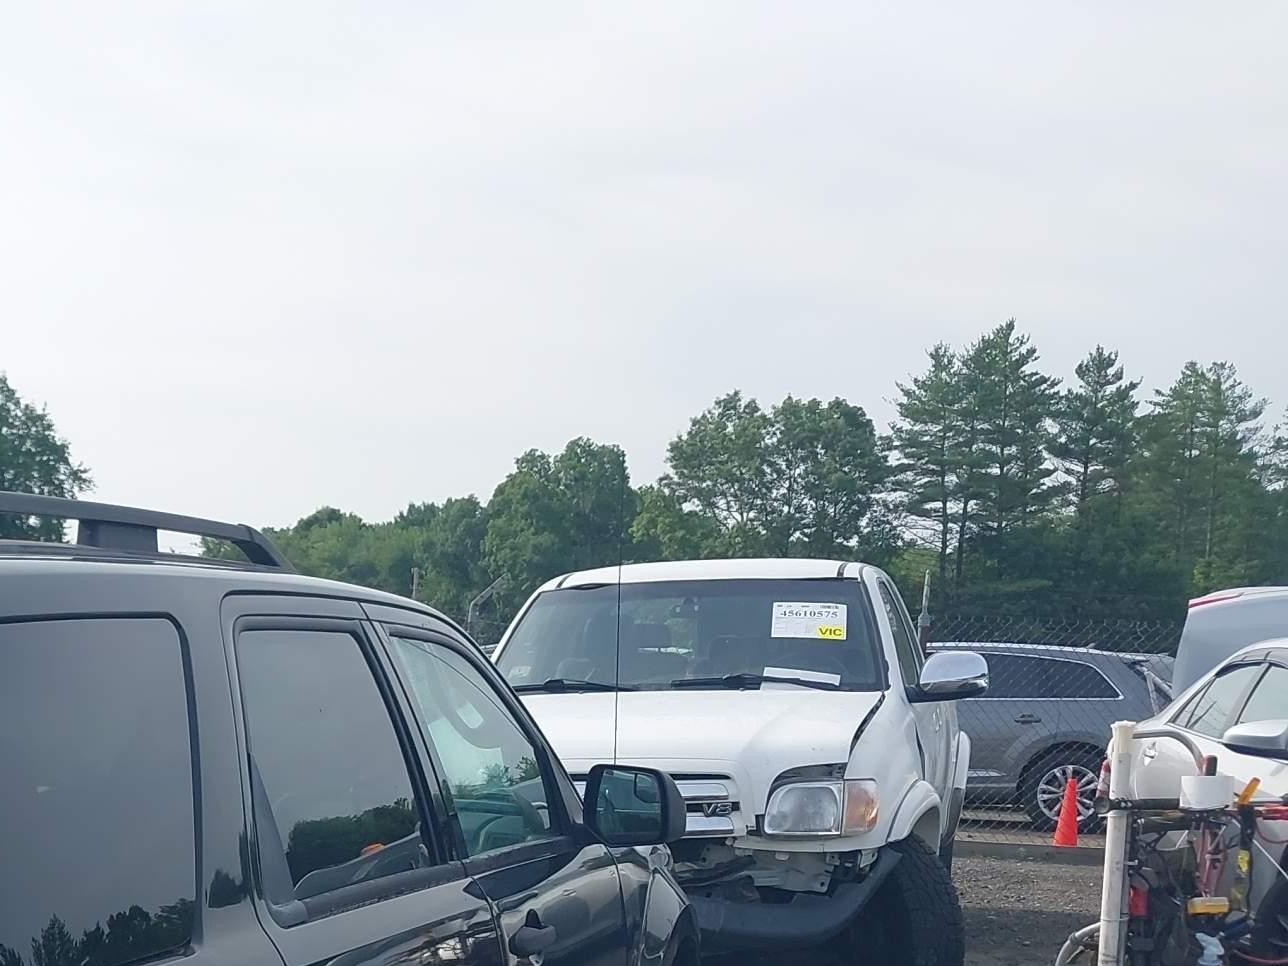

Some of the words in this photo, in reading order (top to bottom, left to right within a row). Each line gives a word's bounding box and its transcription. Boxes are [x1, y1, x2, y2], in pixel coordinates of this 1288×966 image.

[780, 609, 838, 618] 45610575
[818, 627, 843, 637] VIC
[702, 802, 732, 817] V8
